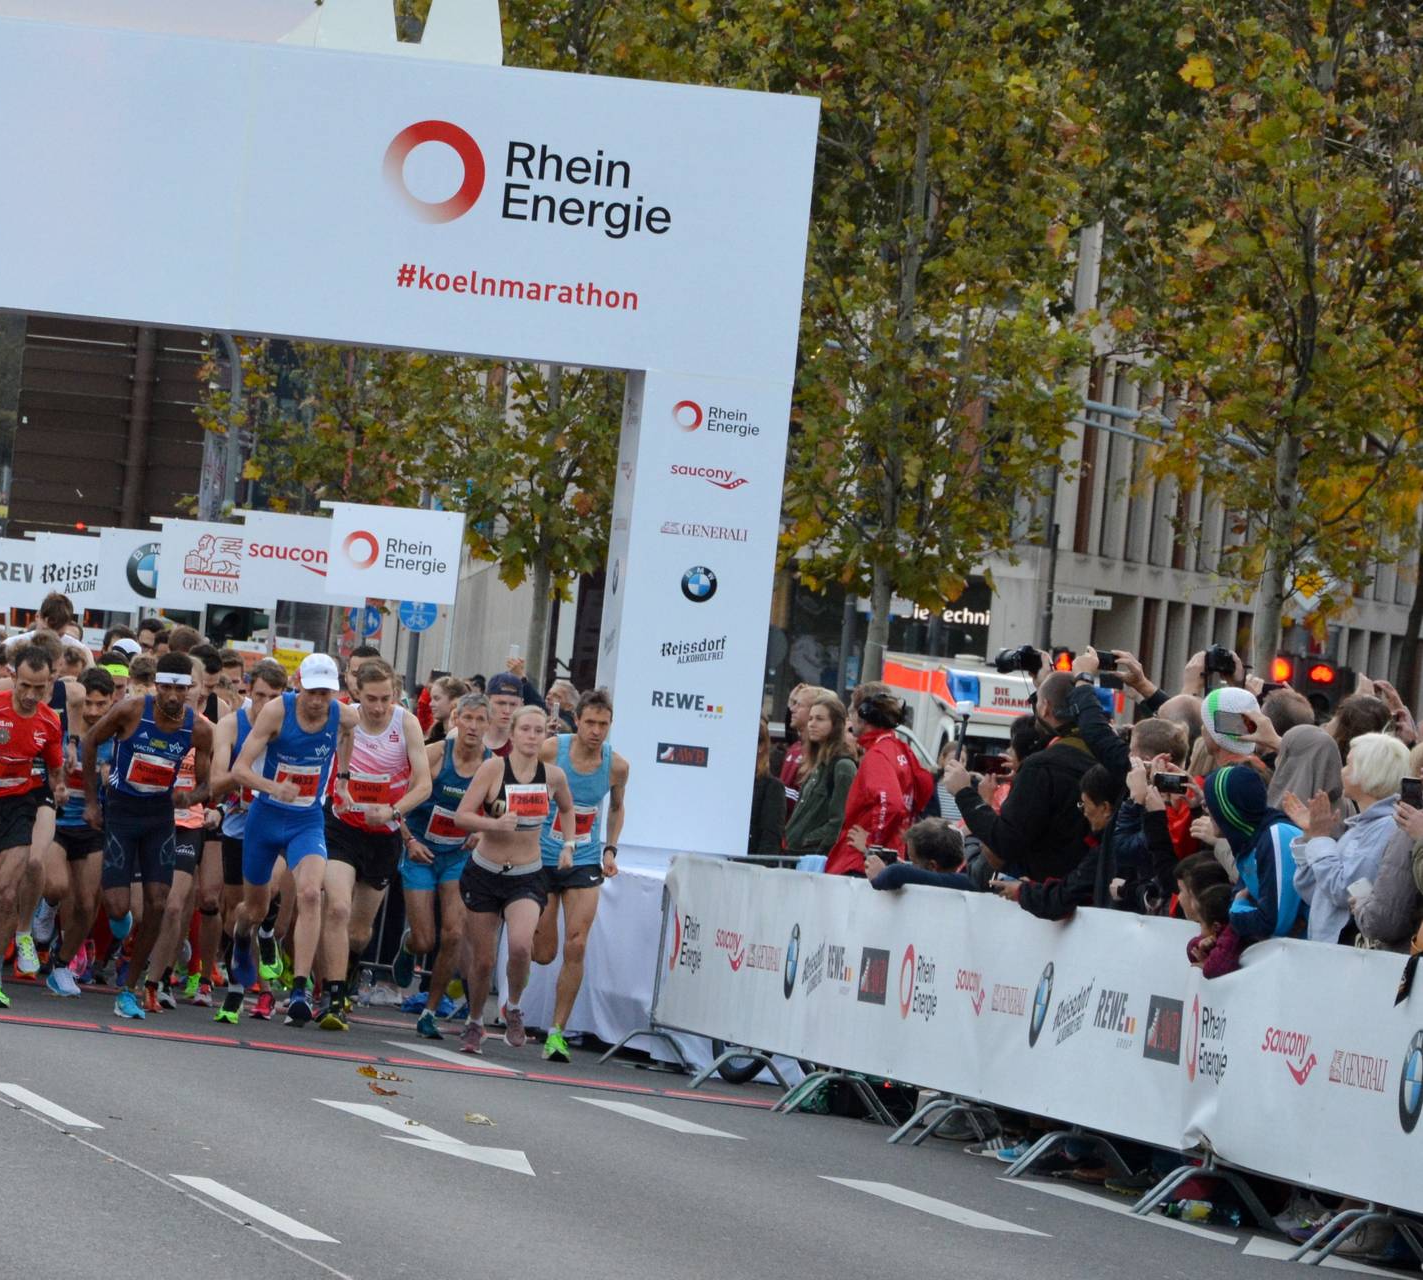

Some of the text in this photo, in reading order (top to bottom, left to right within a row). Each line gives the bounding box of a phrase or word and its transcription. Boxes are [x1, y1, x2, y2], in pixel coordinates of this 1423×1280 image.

[506, 141, 631, 188] Rhein
[502, 182, 672, 239] Energie
[396, 263, 639, 310] #koelnmarathon
[707, 419, 760, 437] Energie
[708, 406, 748, 422] Rhein
[670, 464, 733, 482] saucony
[386, 538, 432, 557] Rhein
[681, 523, 748, 542] GENERALI
[384, 554, 447, 576] Energie
[661, 635, 727, 657] Reissdorf
[651, 690, 705, 712] REWE
[994, 687, 1010, 696] DIE
[917, 955, 936, 985] Rhein
[913, 986, 938, 1022] Energie
[1094, 990, 1129, 1033] REWE
[1202, 1006, 1227, 1041] Rhein
[1261, 1026, 1311, 1064] saucony
[1199, 1043, 1228, 1085] Energie
[1342, 1053, 1389, 1093] GENERALI
